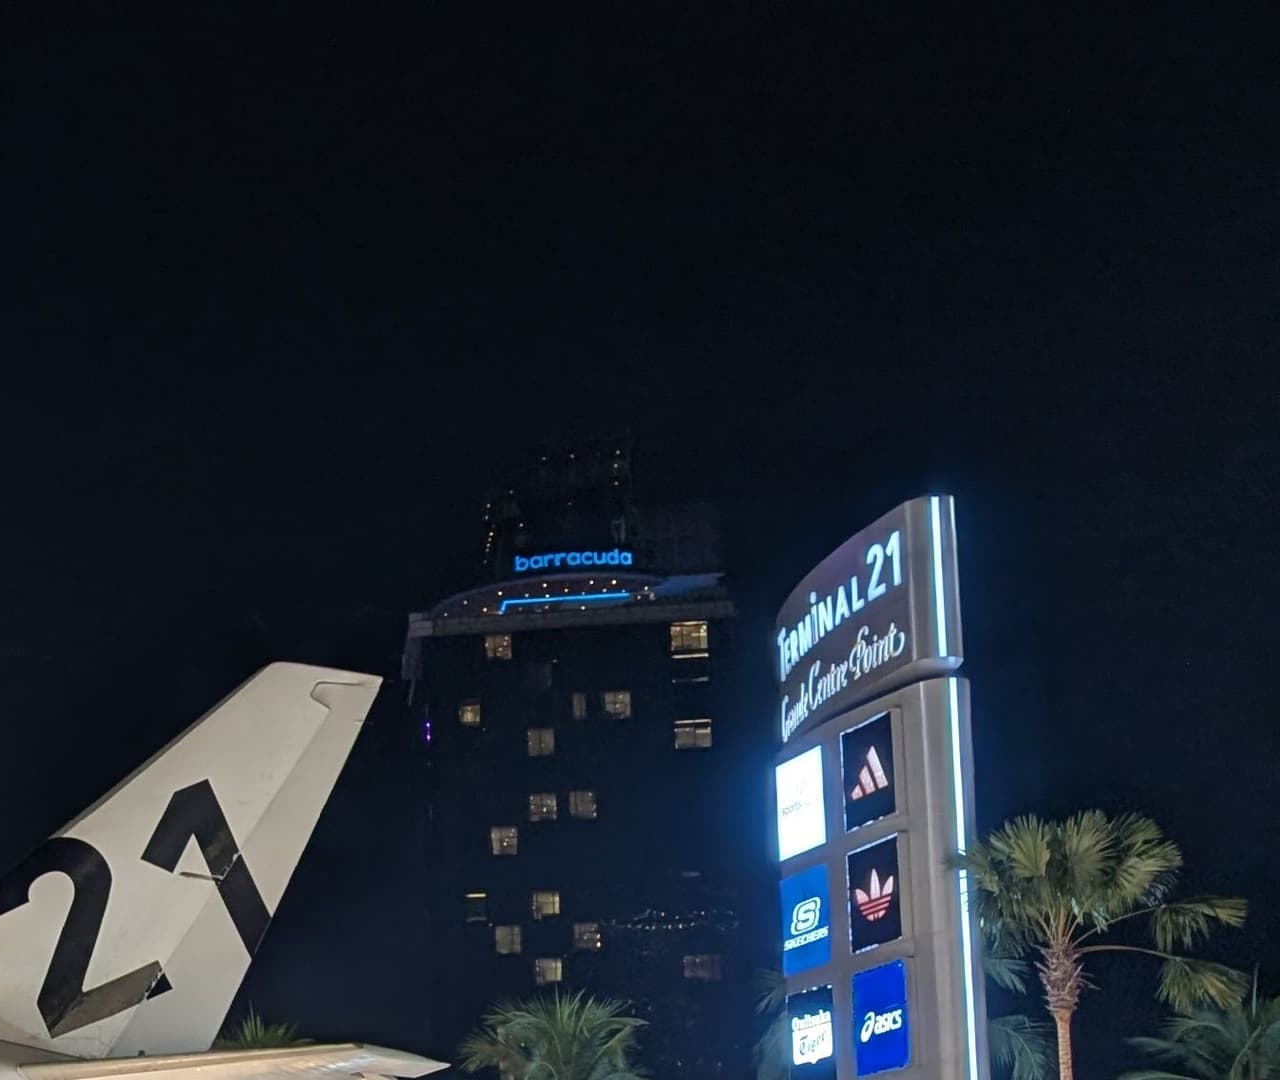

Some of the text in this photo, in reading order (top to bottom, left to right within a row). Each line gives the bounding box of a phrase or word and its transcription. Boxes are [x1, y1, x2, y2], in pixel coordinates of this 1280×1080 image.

[514, 549, 633, 573] barracuda
[866, 530, 903, 602] 21
[808, 660, 848, 711] Centre
[848, 622, 906, 681] Point
[784, 926, 830, 951] SKECHERS
[799, 1033, 826, 1057] Tiger
